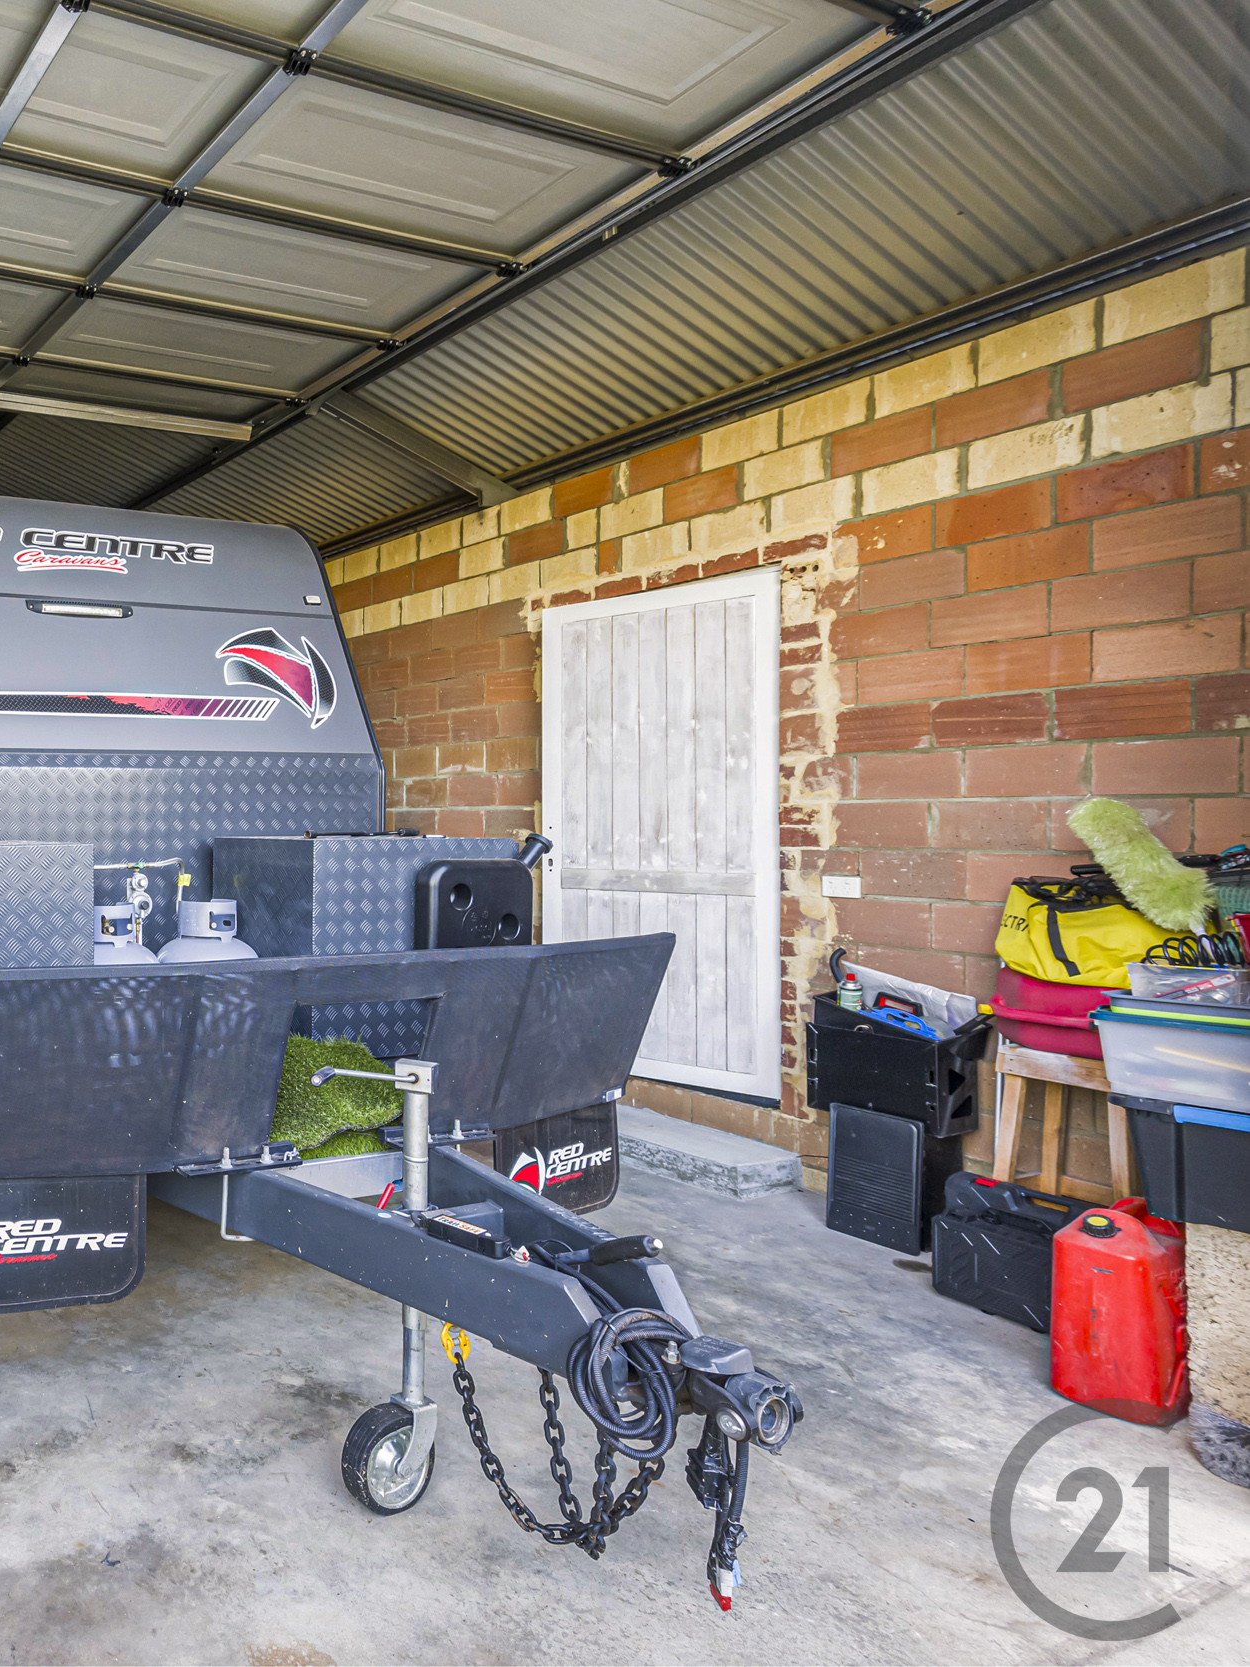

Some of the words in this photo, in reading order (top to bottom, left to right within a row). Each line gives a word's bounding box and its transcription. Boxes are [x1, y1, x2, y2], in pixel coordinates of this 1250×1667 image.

[16, 550, 123, 567] Caravans
[21, 528, 213, 564] CENTRE
[546, 1147, 612, 1178] CENTRE
[548, 1142, 584, 1165] RED
